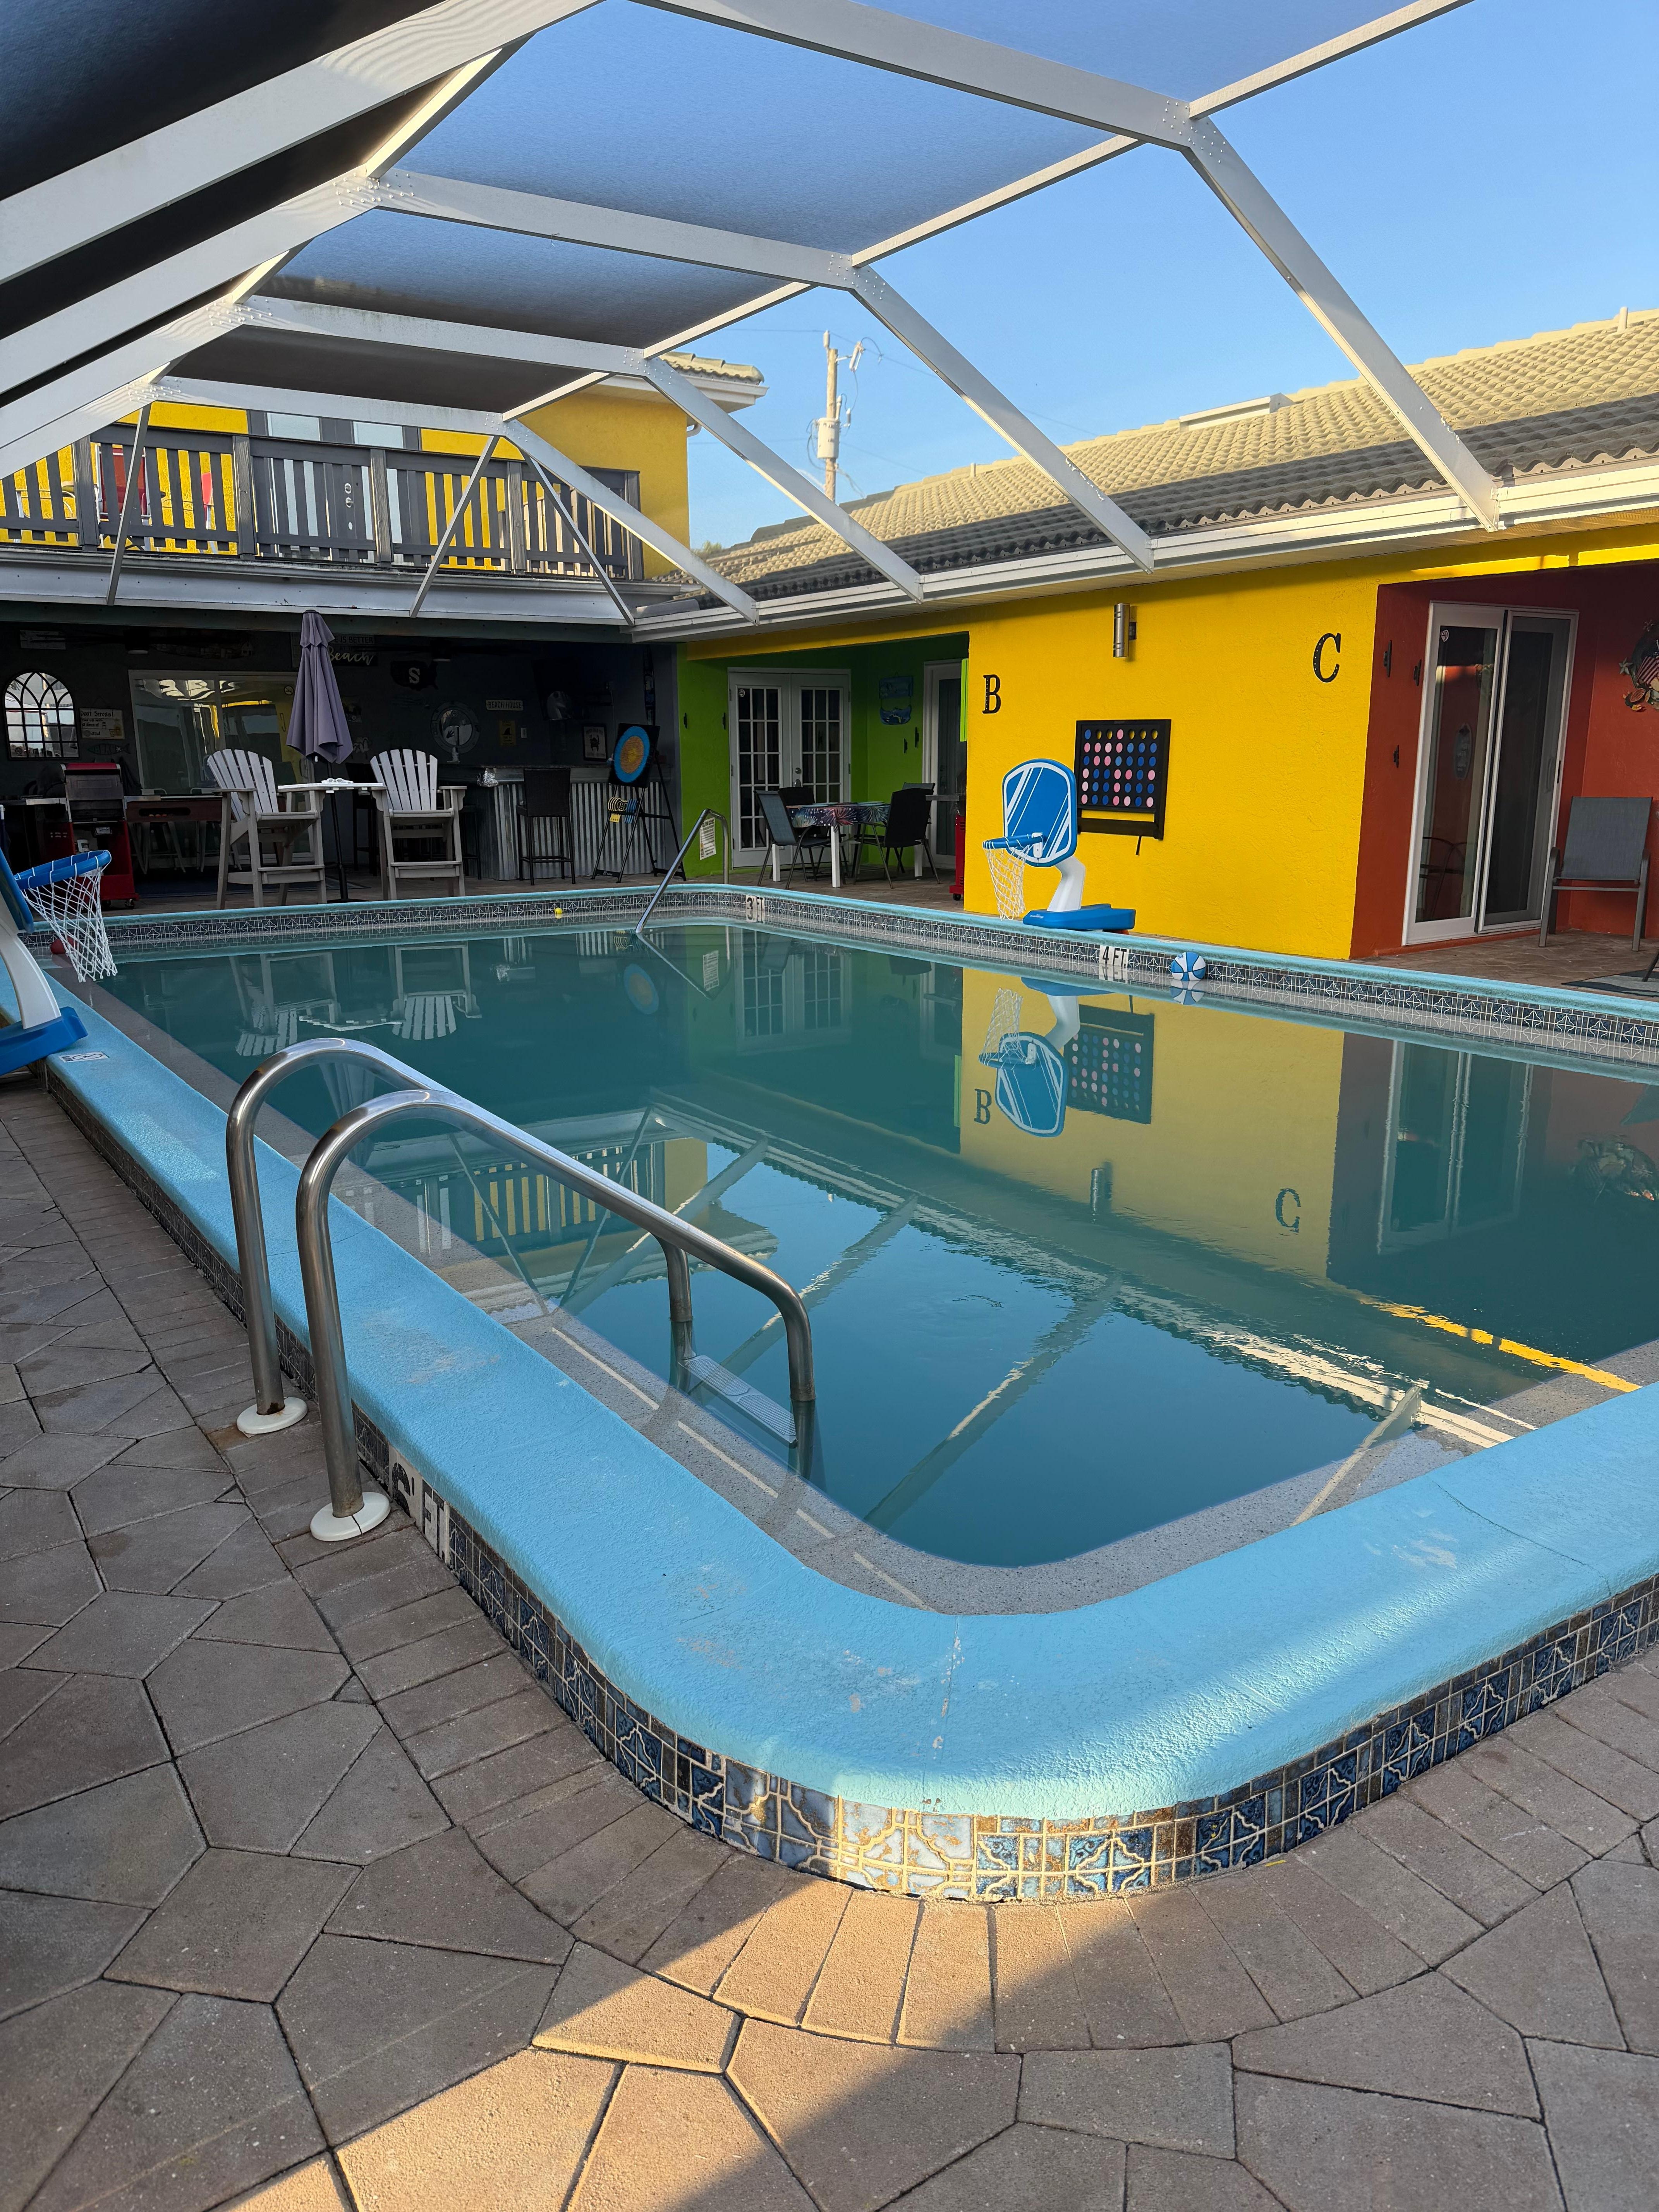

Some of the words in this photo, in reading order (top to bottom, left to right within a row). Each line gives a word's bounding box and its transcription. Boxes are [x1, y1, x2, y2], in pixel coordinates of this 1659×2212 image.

[328, 645, 376, 666] Beach
[1313, 632, 1341, 683] C
[409, 667, 420, 684] S
[982, 674, 1001, 714] B
[1103, 946, 1109, 963] 4
